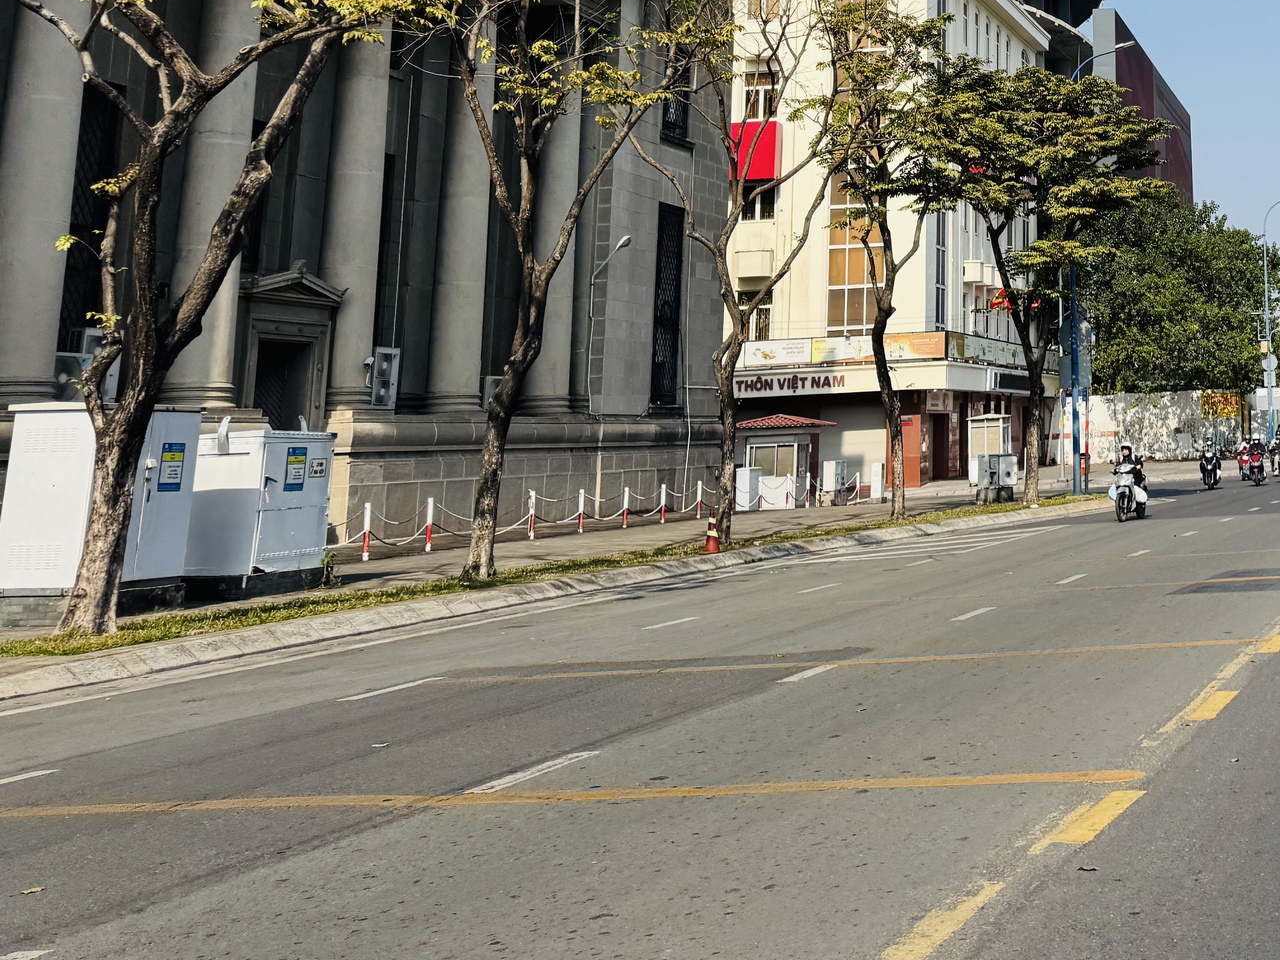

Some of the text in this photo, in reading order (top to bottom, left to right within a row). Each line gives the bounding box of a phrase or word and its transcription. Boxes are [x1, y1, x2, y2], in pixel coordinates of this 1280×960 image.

[735, 374, 845, 394] THÔN VIỆT NAM
